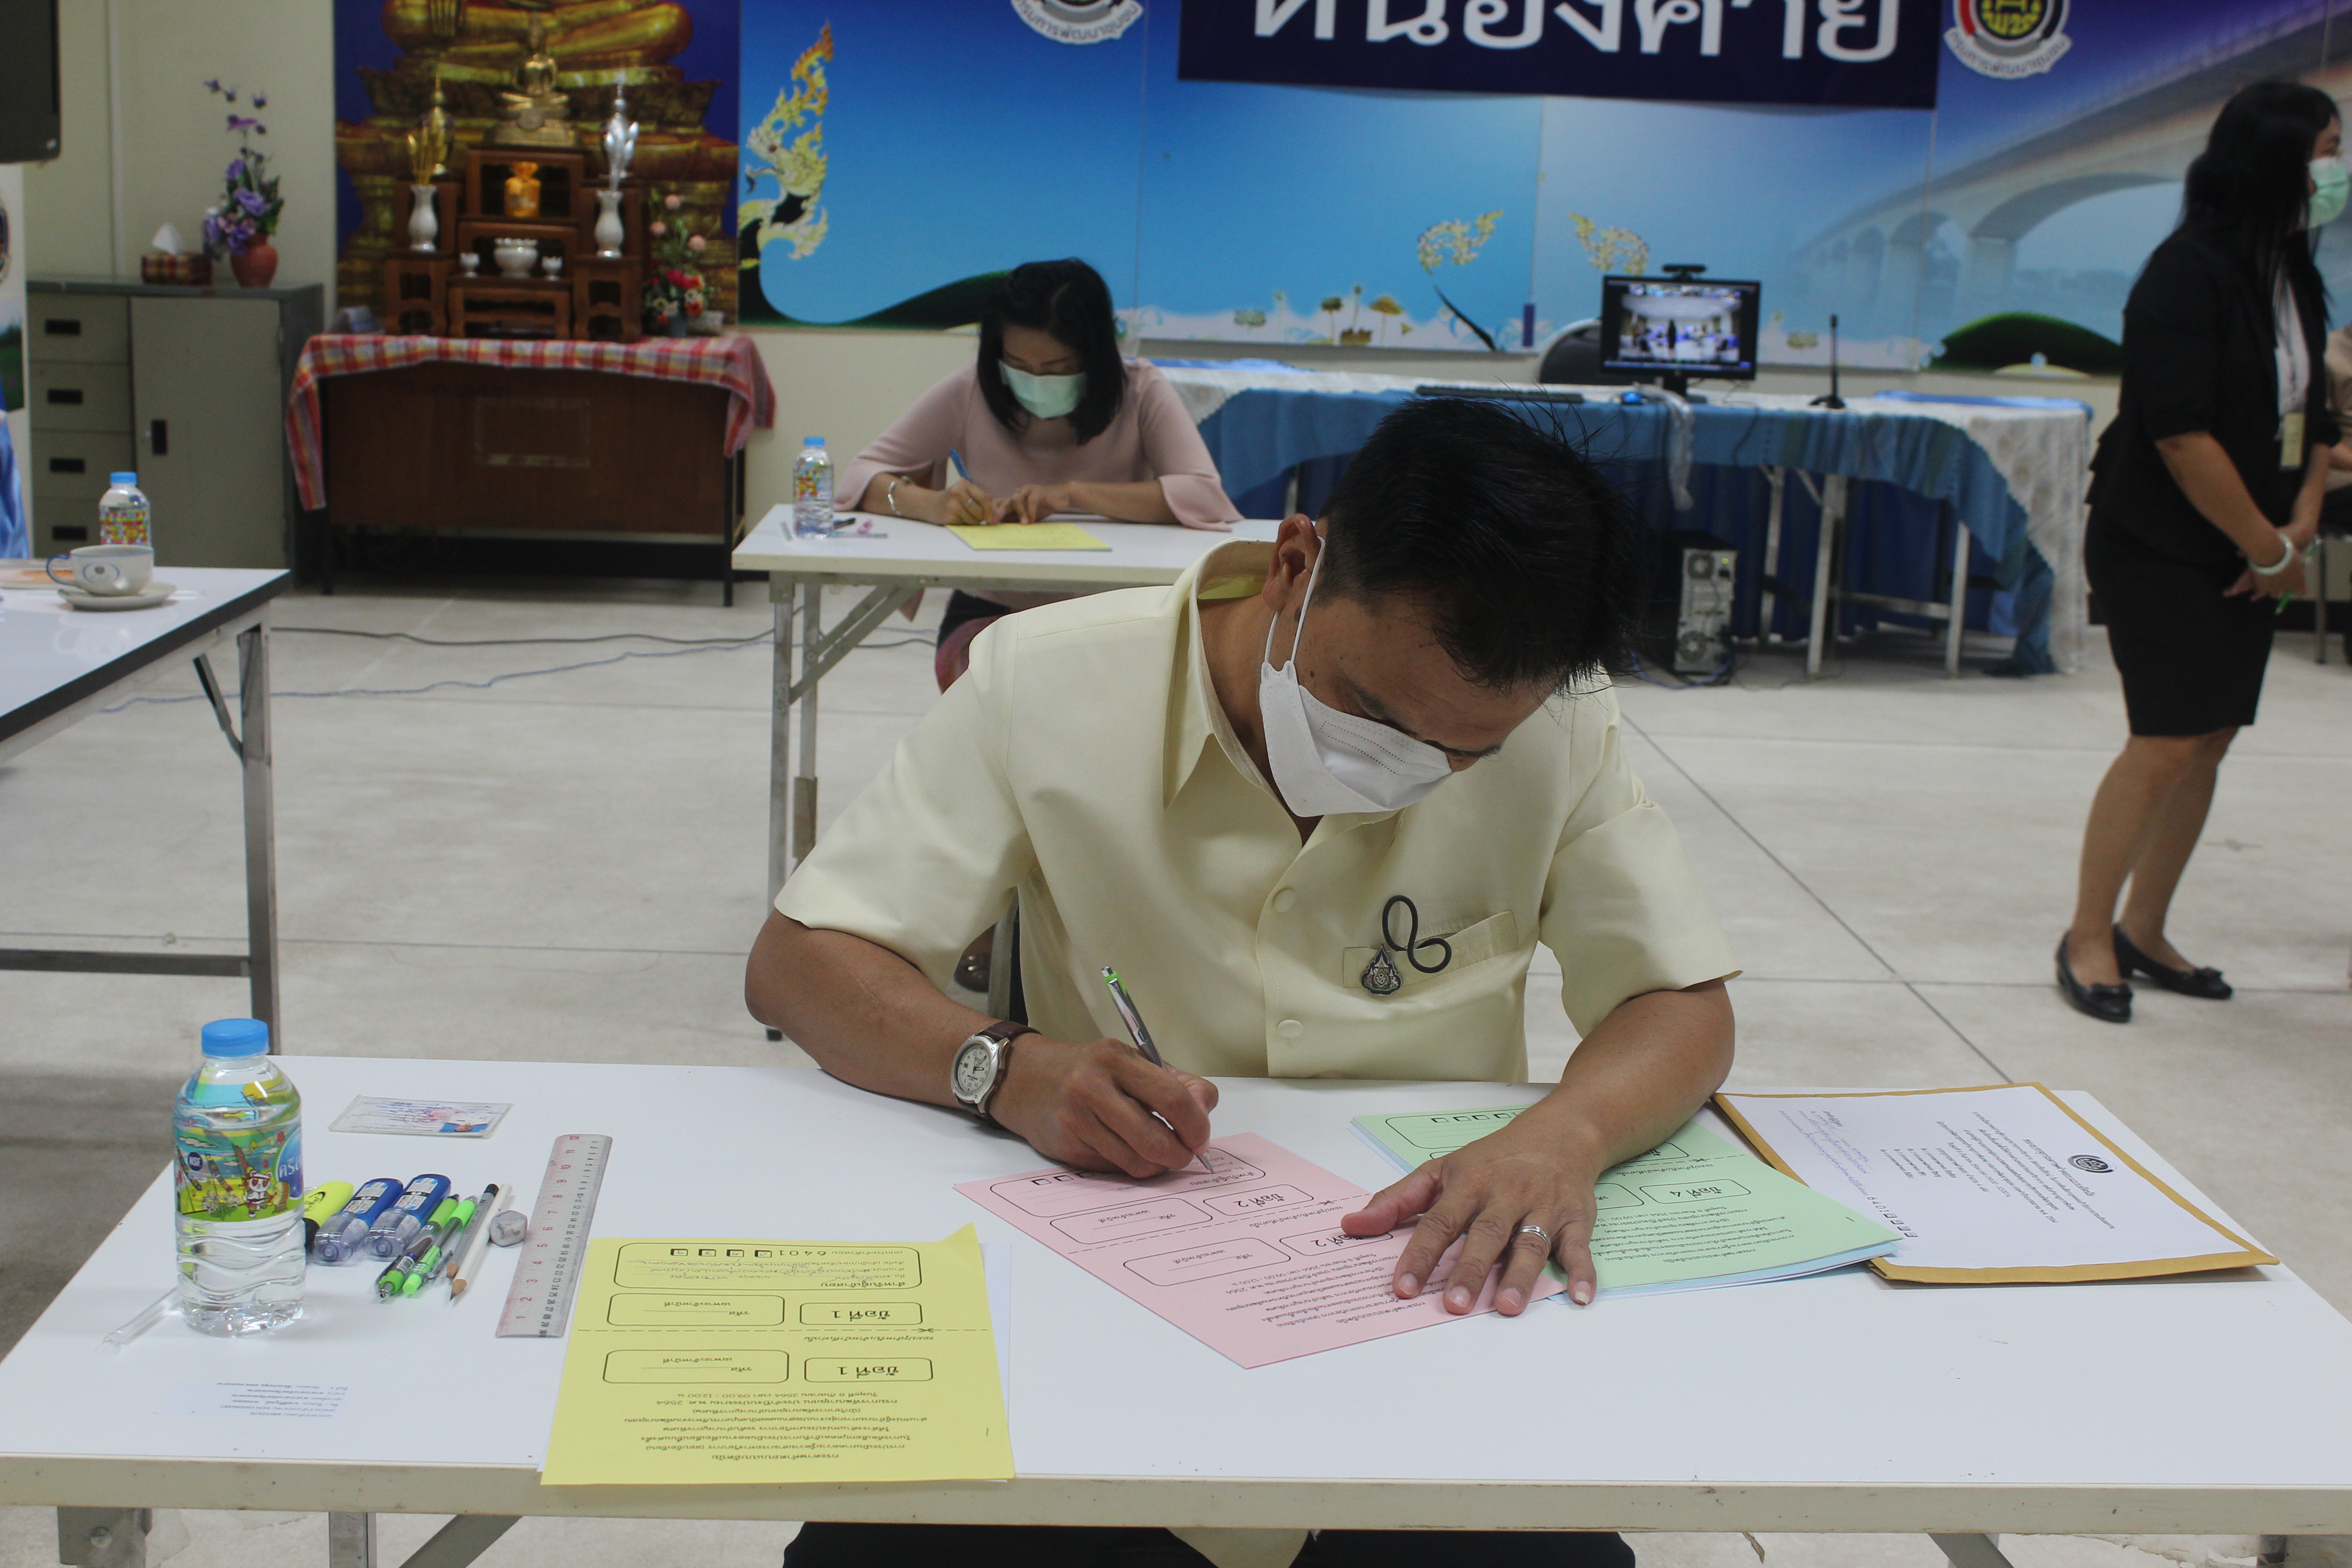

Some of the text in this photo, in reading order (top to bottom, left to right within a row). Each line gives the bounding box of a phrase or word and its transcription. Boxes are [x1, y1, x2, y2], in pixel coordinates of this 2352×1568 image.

[1190, 1171, 1255, 1186] สำหรับผู้เข้าสอบ
[1686, 1186, 1722, 1198] ข้อที่
[1232, 1192, 1284, 1208] ข้อที่ 2
[1310, 1239, 1326, 1248] 2
[1172, 1249, 1226, 1265] เฉพาะเจ้าหน้าที่
[1301, 1263, 1320, 1272] 2564
[1225, 1287, 1246, 1295] 2564
[849, 1311, 890, 1321] ข้อที่
[837, 1366, 899, 1378] ข้อที่ 1
